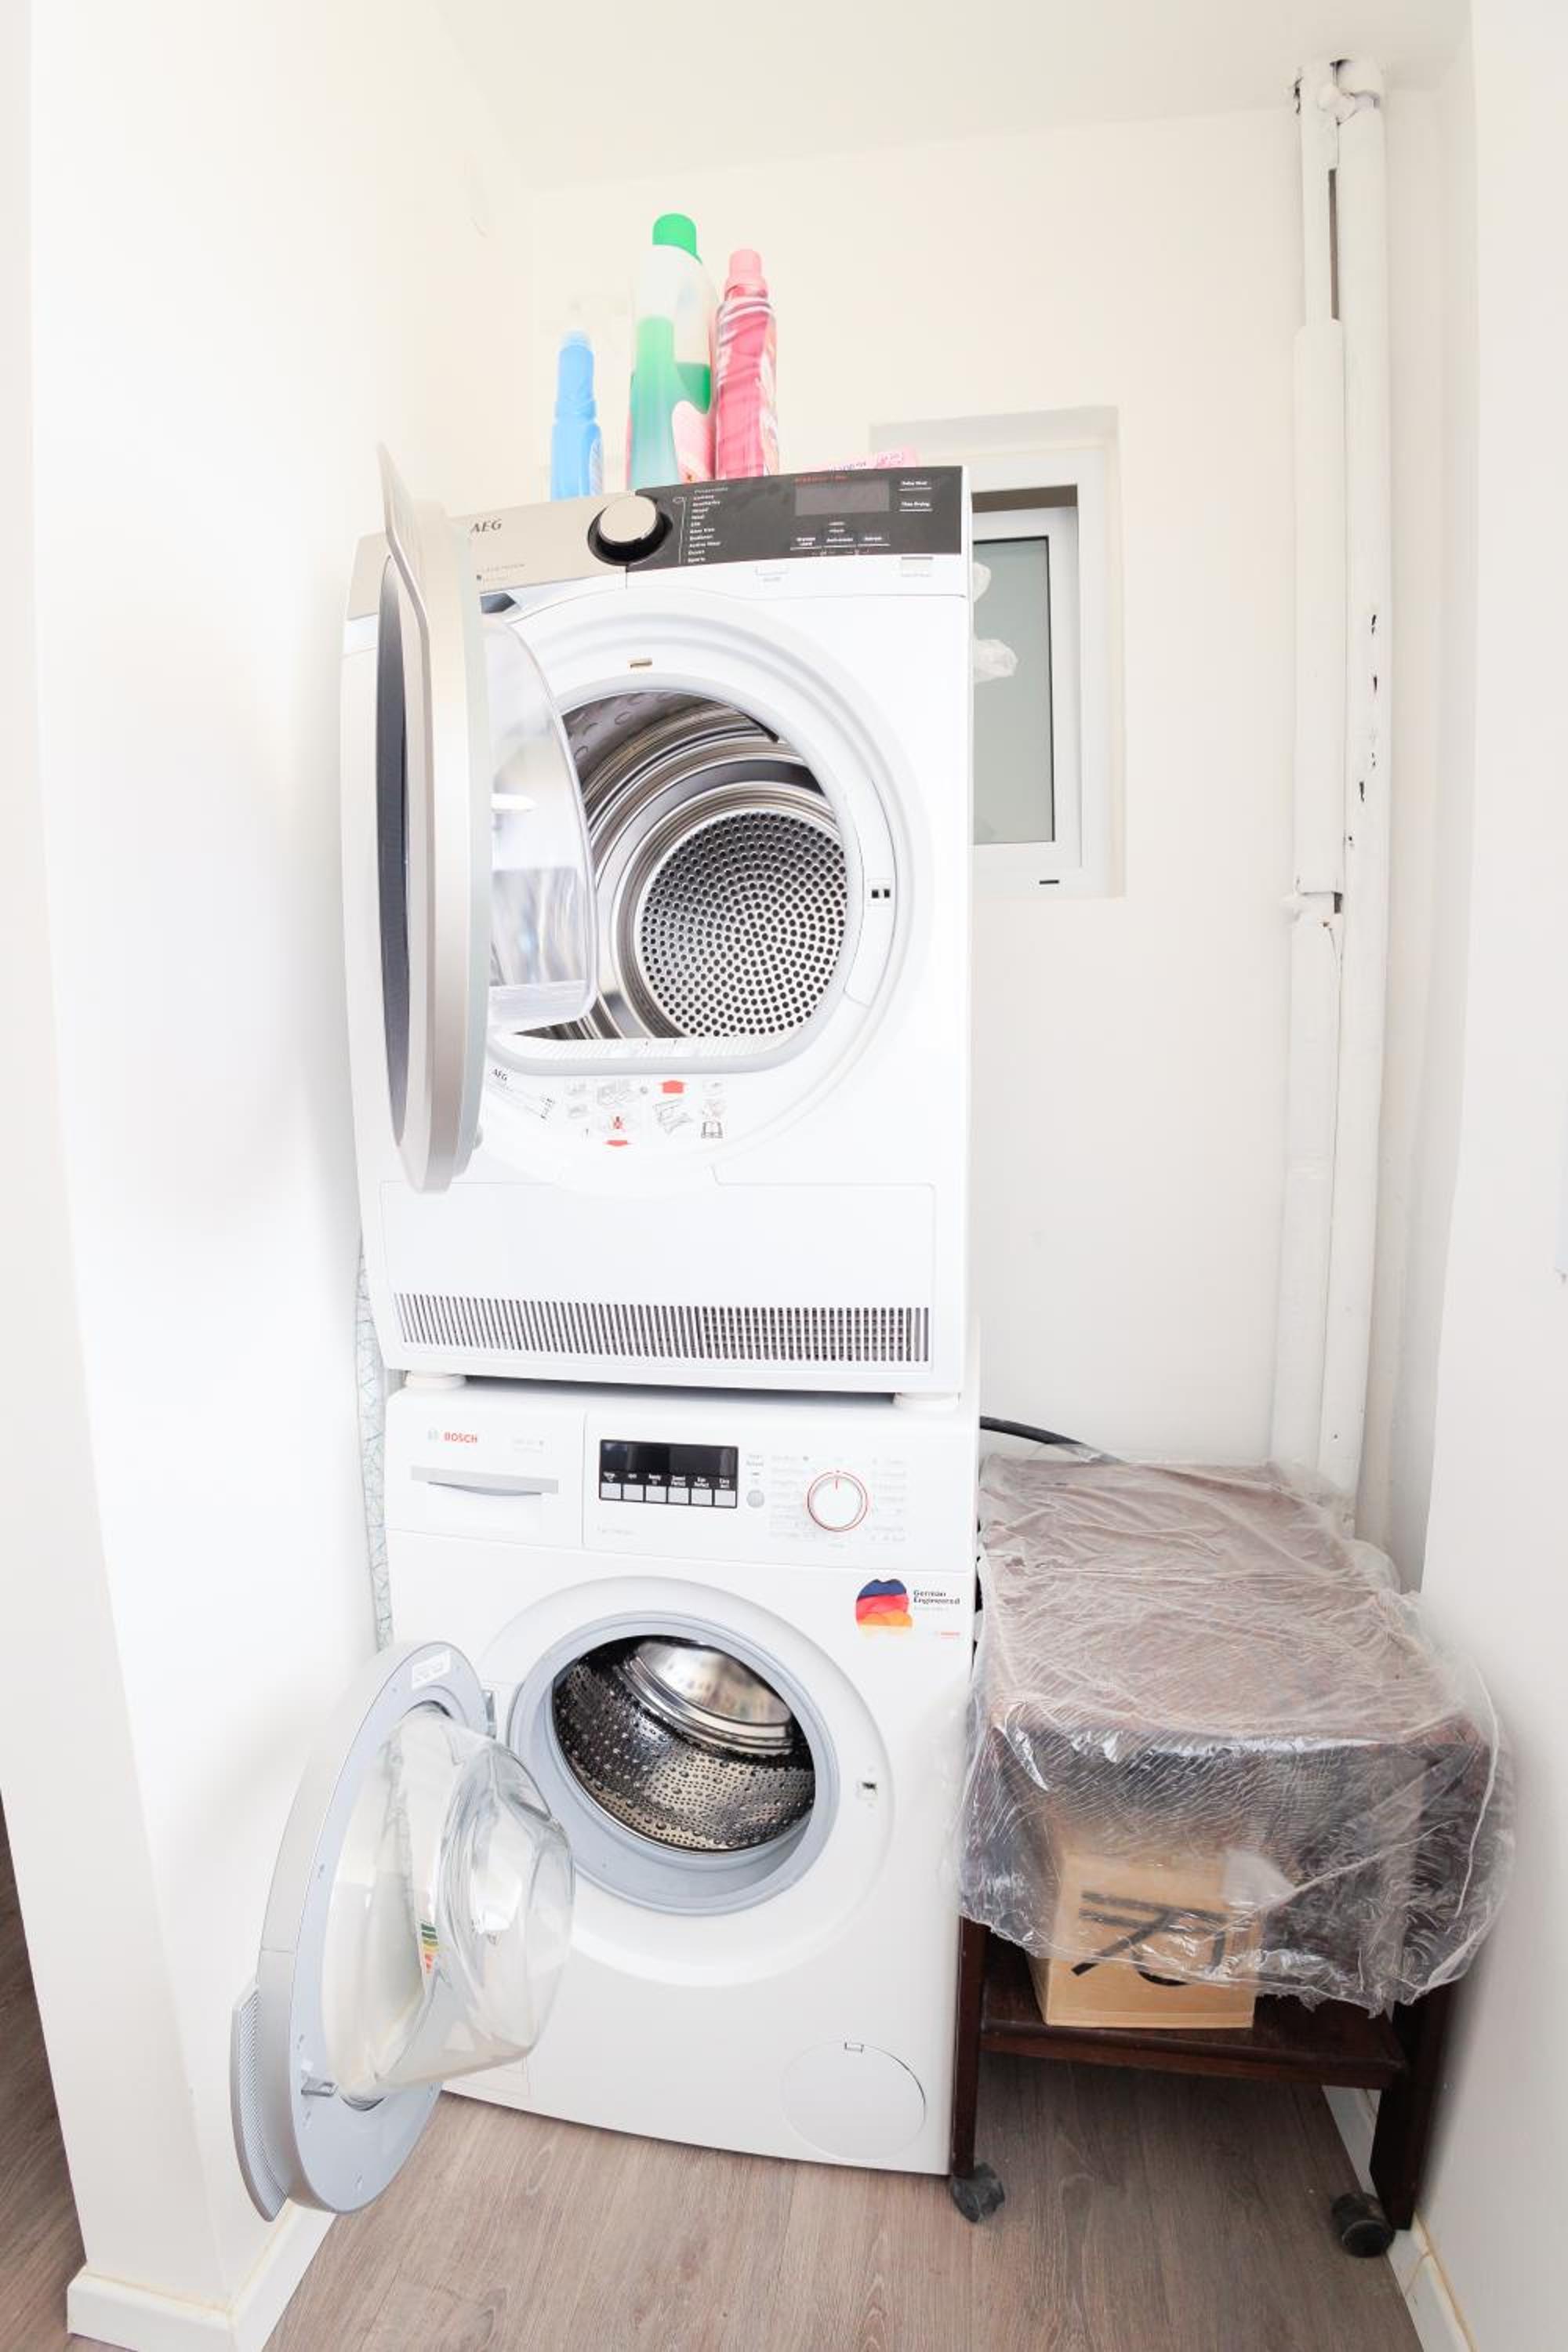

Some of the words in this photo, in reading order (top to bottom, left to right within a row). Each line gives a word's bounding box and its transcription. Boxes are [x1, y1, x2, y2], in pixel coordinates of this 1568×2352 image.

[470, 518, 502, 533] AEG
[491, 1069, 508, 1081] AEG
[444, 1431, 477, 1443] BOSCH
